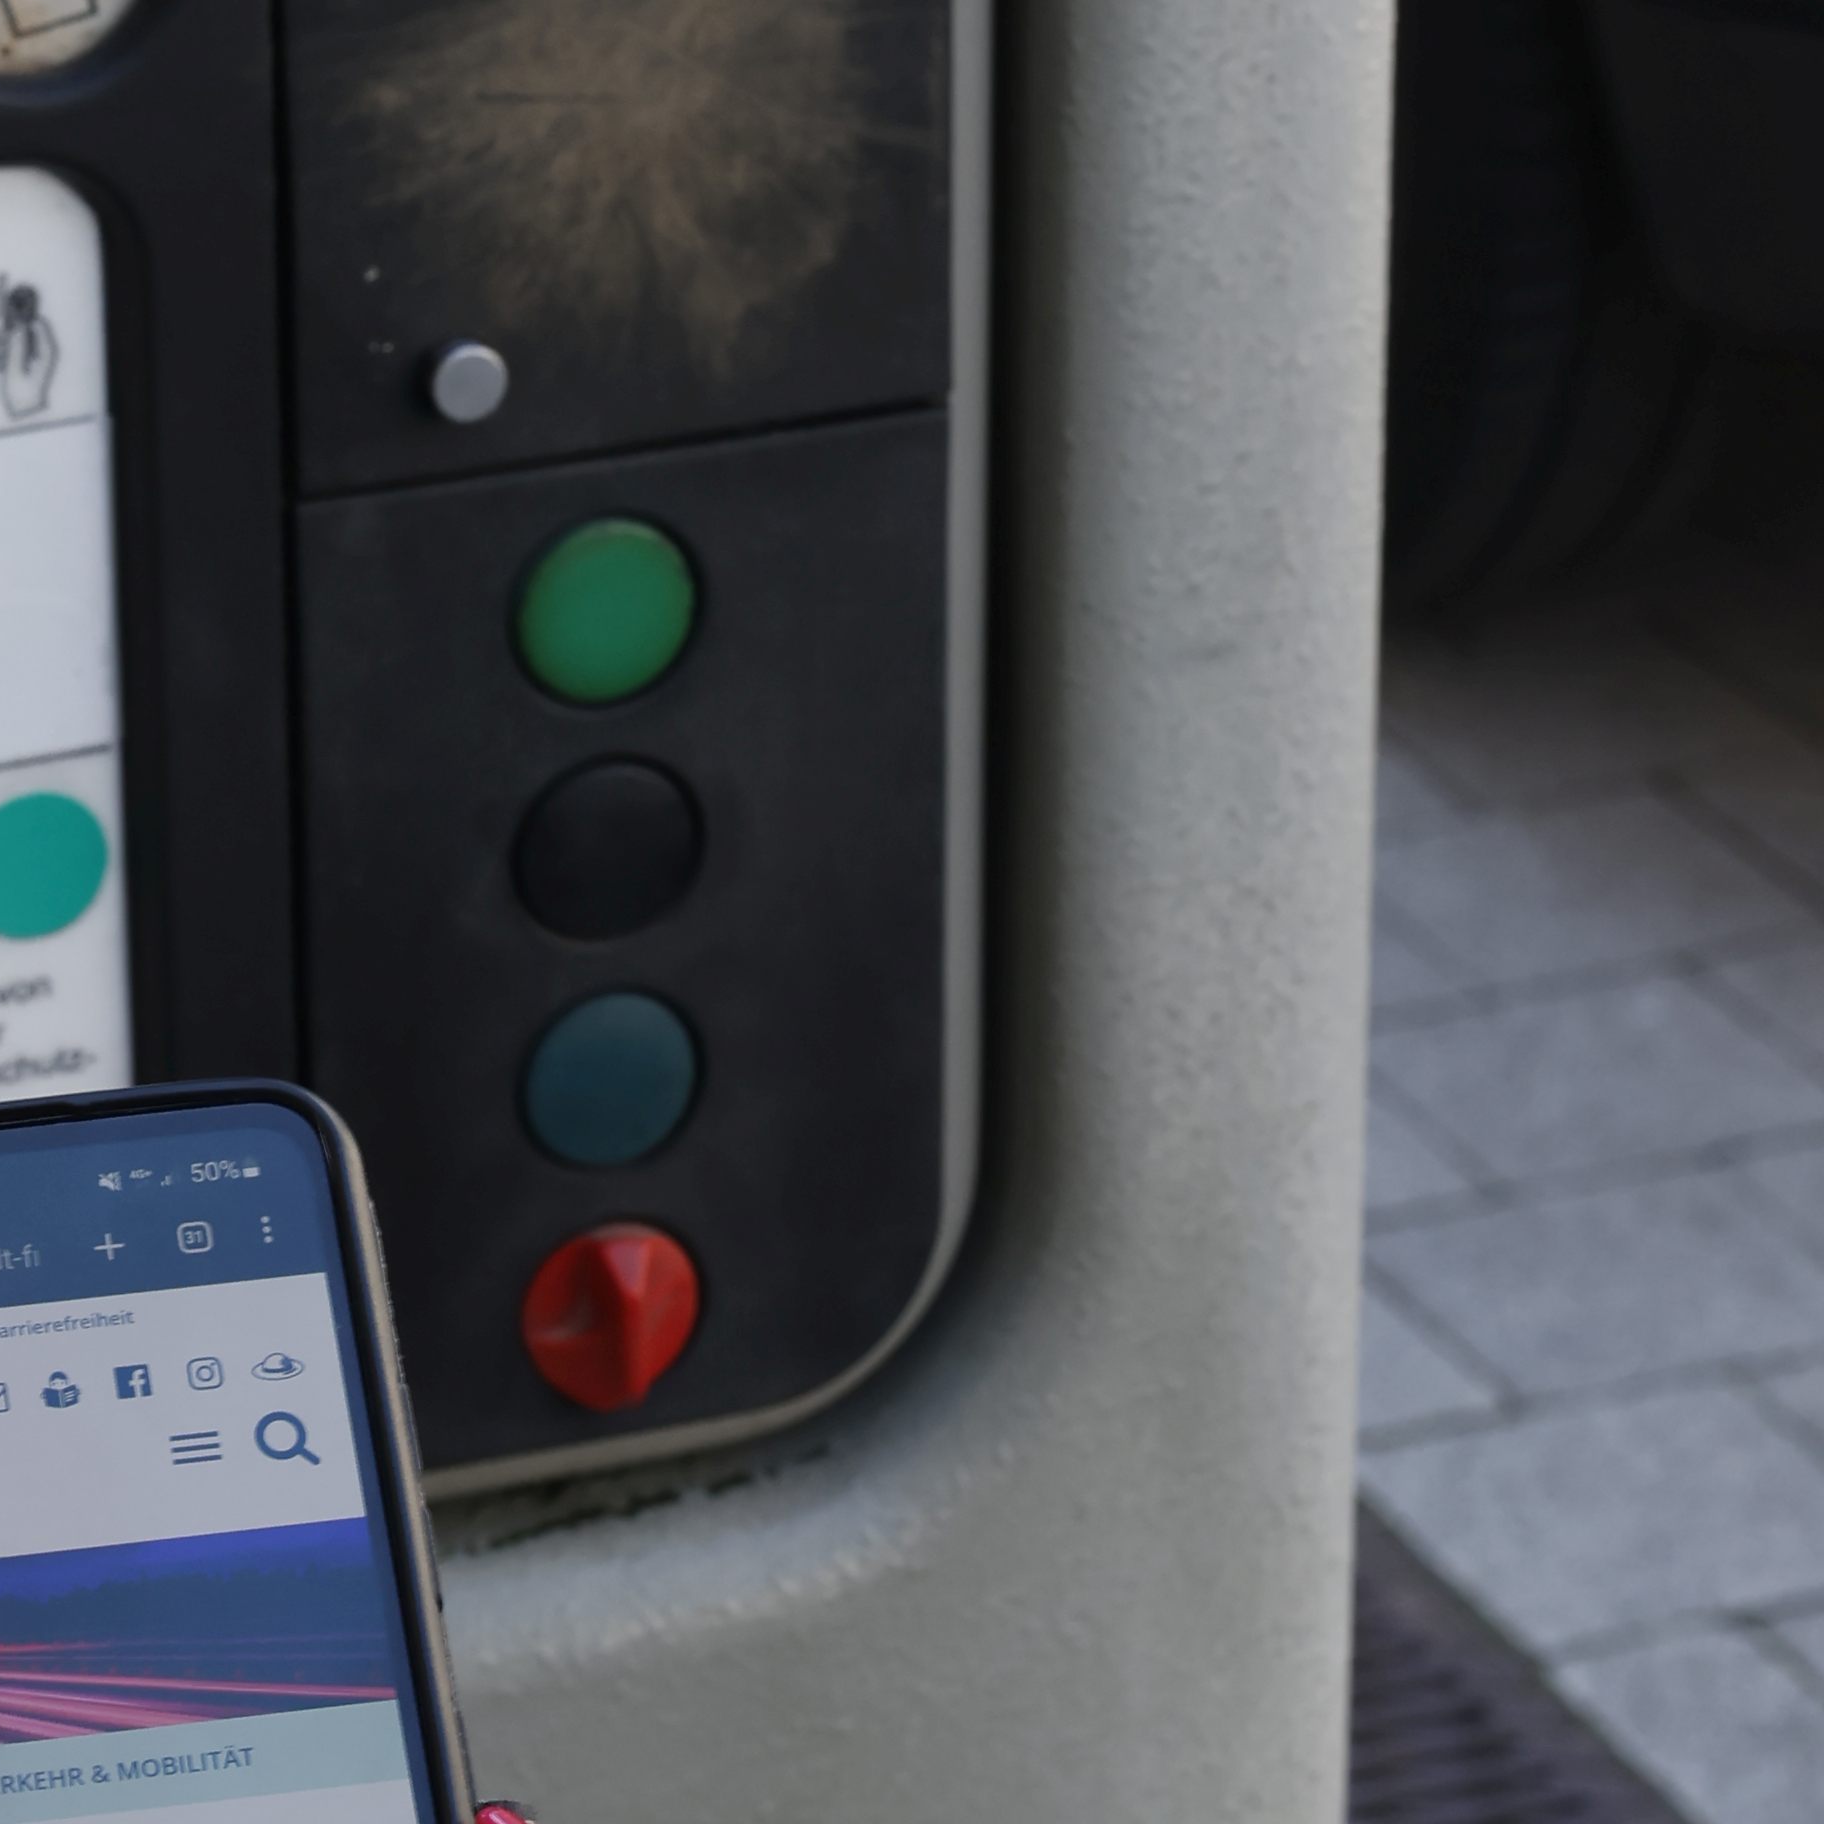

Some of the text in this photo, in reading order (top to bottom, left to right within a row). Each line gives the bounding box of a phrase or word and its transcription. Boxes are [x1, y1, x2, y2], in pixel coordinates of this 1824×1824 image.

[189, 1158, 241, 1183] 50%
[179, 1228, 204, 1248] 31
[89, 1763, 111, 1784] &
[115, 1743, 254, 1782] MOBILITÄT
